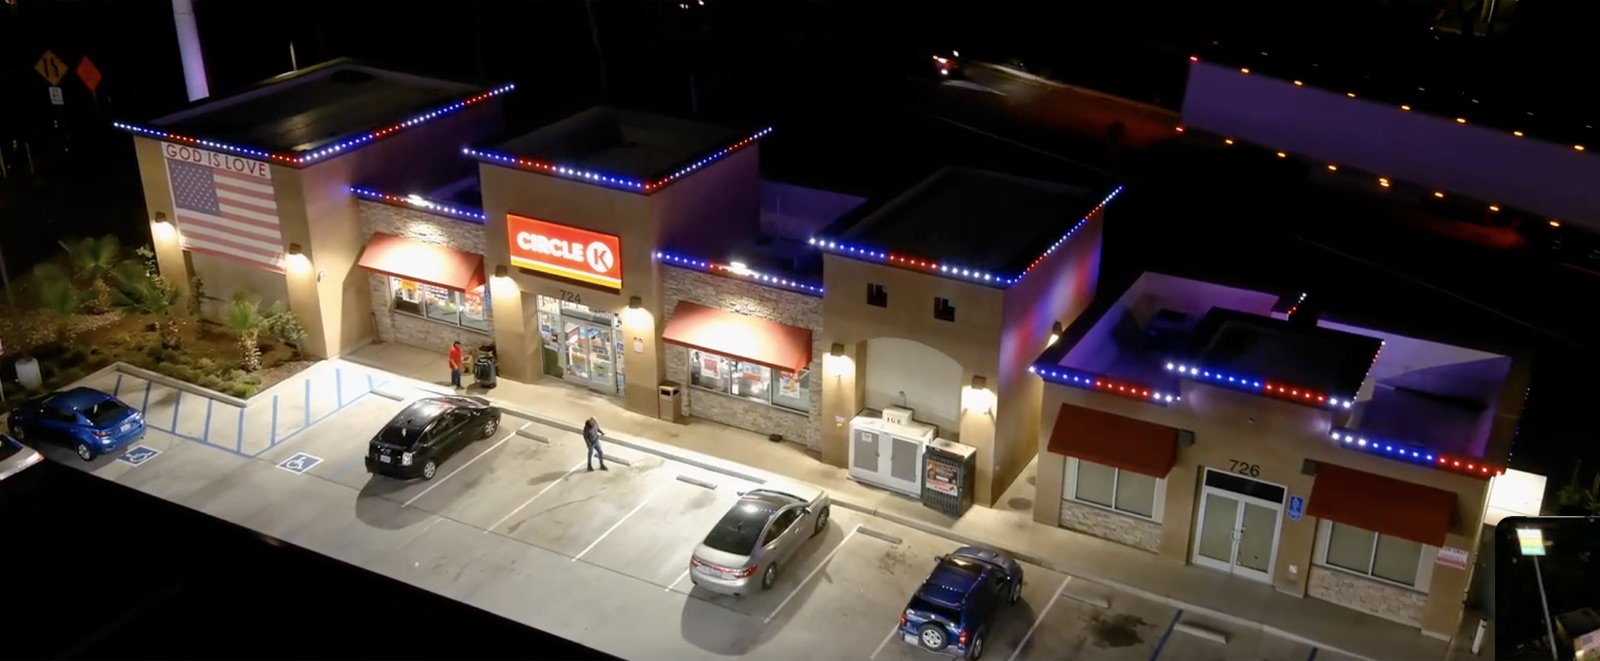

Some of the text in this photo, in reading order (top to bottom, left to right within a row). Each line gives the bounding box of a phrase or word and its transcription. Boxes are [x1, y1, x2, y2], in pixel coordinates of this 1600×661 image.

[166, 144, 267, 177] GOD IS LOVE
[516, 231, 610, 271] CIRCLE K
[559, 289, 582, 304] 724
[1229, 459, 1261, 478] 726
